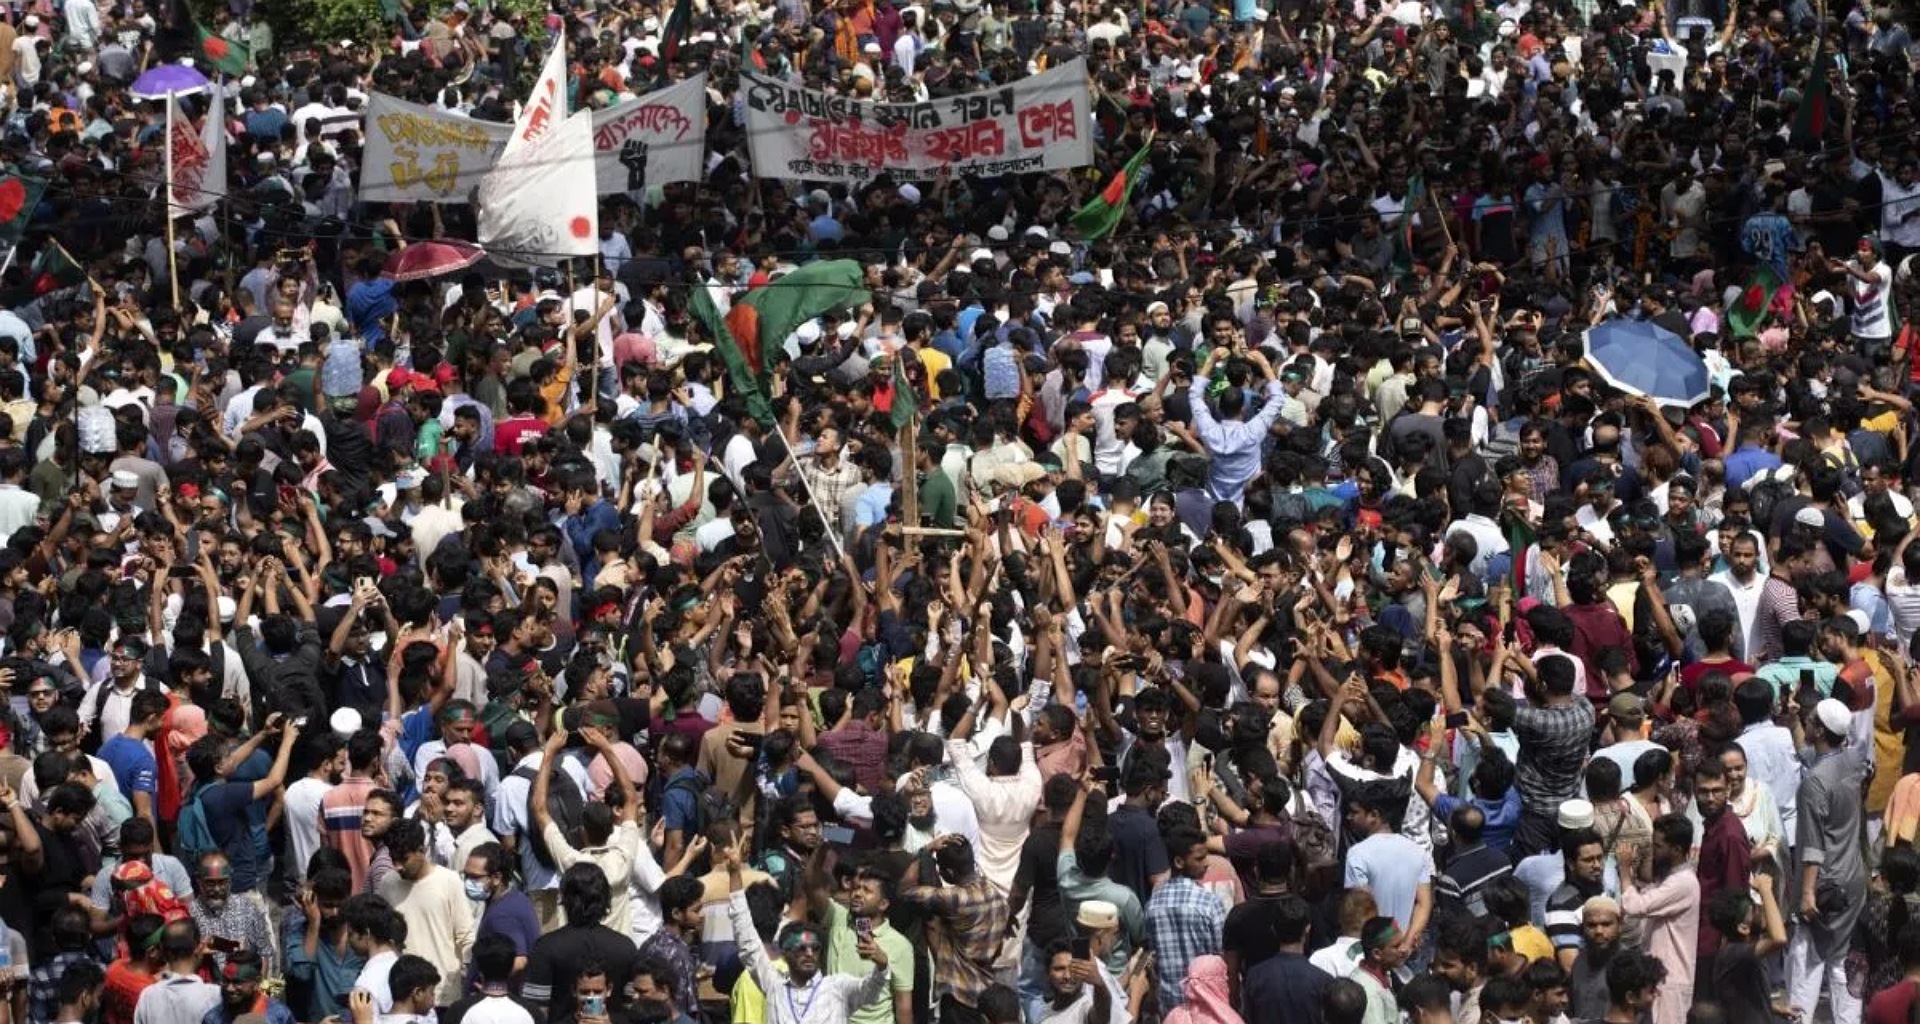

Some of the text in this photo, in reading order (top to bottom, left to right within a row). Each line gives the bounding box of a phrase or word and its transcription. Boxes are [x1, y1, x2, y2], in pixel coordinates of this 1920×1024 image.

[952, 87, 1014, 122] পতন
[594, 104, 691, 150] বাংলাদেশ
[924, 120, 1005, 162] হয়নি
[1018, 99, 1077, 148] শেষ
[987, 153, 1045, 174] বাংলাদেশ
